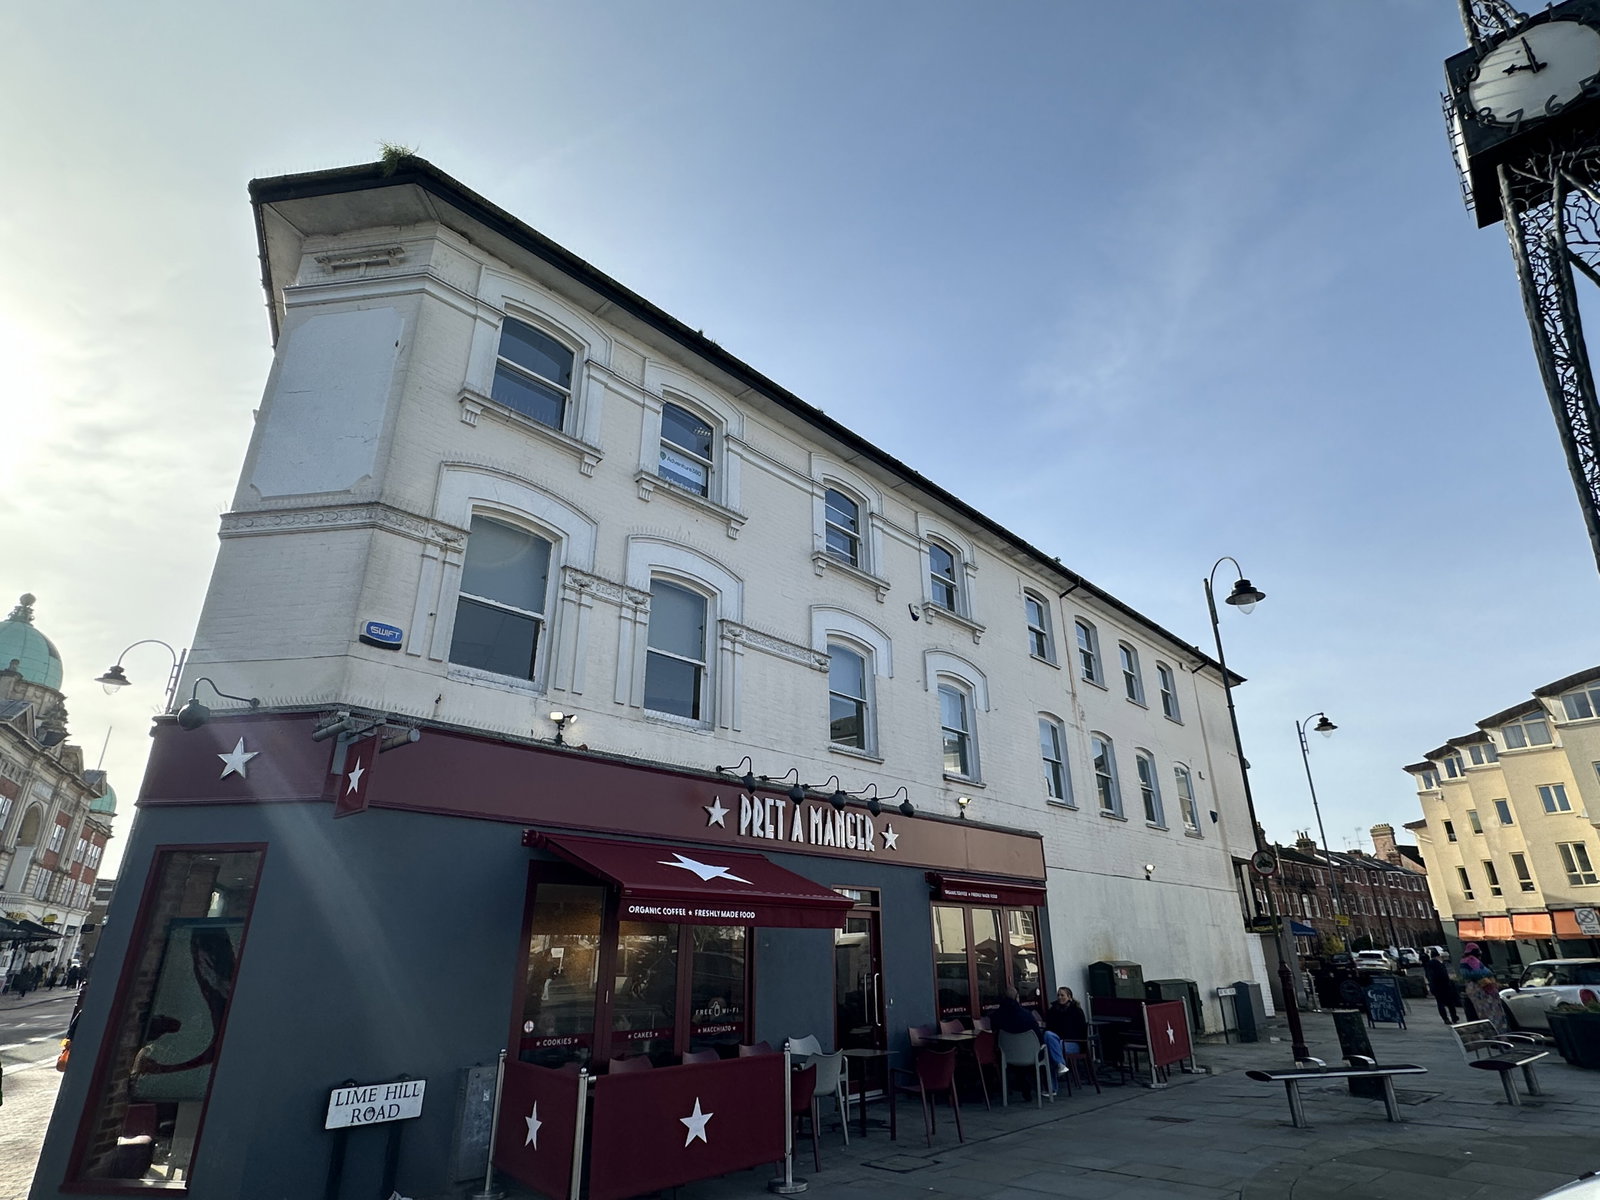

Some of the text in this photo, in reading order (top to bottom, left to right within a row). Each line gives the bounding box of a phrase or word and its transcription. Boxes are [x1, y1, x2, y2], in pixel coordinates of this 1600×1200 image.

[1545, 95, 1563, 116] 6
[1506, 108, 1524, 135] 7
[370, 625, 400, 639] SWIFT
[740, 793, 876, 852] PRET A MANGER
[628, 905, 756, 919] ORGANIC COFFEE FRESHLY MADE FOOD
[695, 1008, 713, 1016] FREE
[633, 1031, 653, 1039] CAKES
[702, 1025, 732, 1033] MACCHIATO
[542, 1037, 572, 1047] COOKIES
[335, 1083, 420, 1107] LIME HILL
[350, 1103, 400, 1124] ROAD
